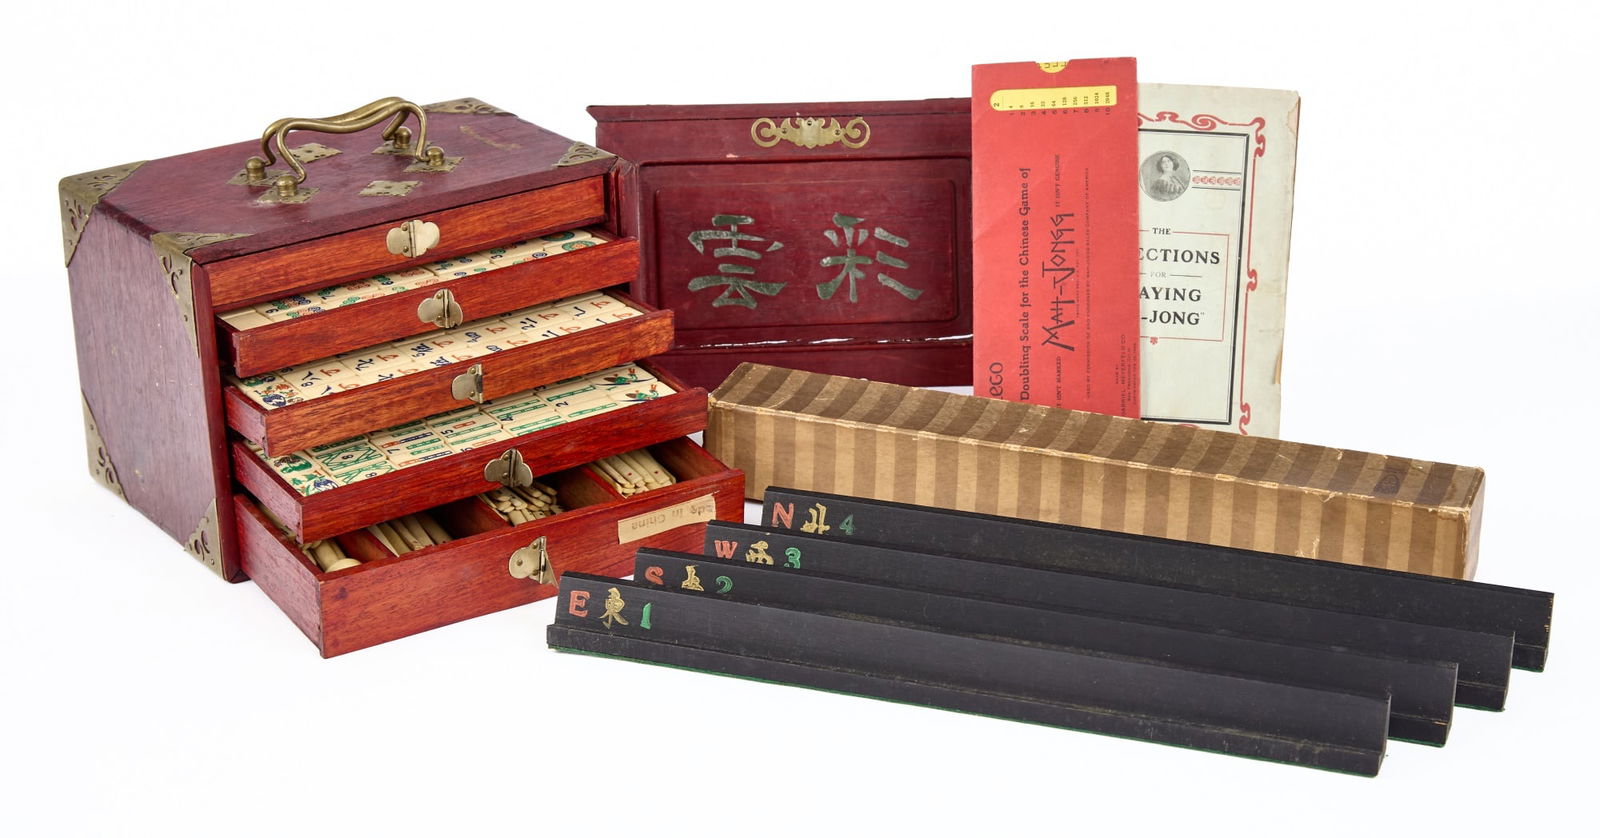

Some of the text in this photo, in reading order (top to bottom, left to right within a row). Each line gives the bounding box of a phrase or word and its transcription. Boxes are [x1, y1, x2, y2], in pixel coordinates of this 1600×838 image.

[1152, 227, 1172, 235] THE
[1019, 168, 1031, 401] Doubling Scale for the Chinese Game of
[1150, 271, 1167, 279] FOR
[631, 513, 666, 531] China
[771, 502, 795, 529] N
[839, 514, 856, 536] 4
[714, 540, 738, 559] W
[783, 547, 801, 569] 3
[568, 590, 591, 618] E
[640, 602, 651, 630] 1
